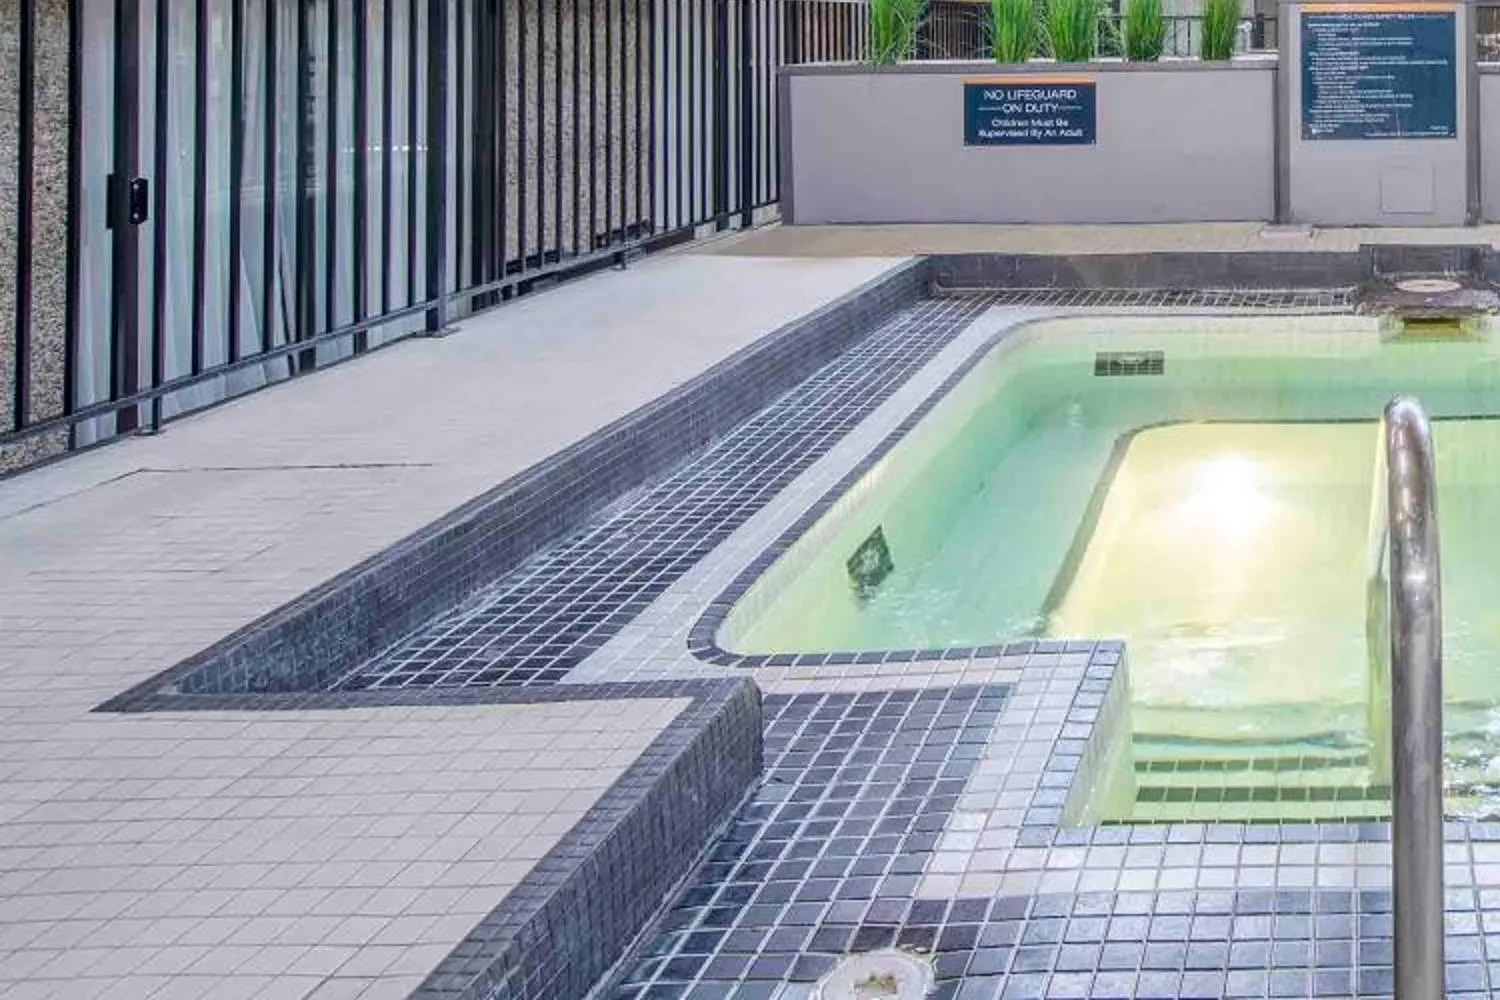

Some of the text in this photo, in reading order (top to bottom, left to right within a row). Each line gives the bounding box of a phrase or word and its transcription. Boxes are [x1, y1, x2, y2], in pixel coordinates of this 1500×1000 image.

[984, 89, 1077, 100] NO LIFEGUARD
[1002, 103, 1059, 113] ON DUTY
